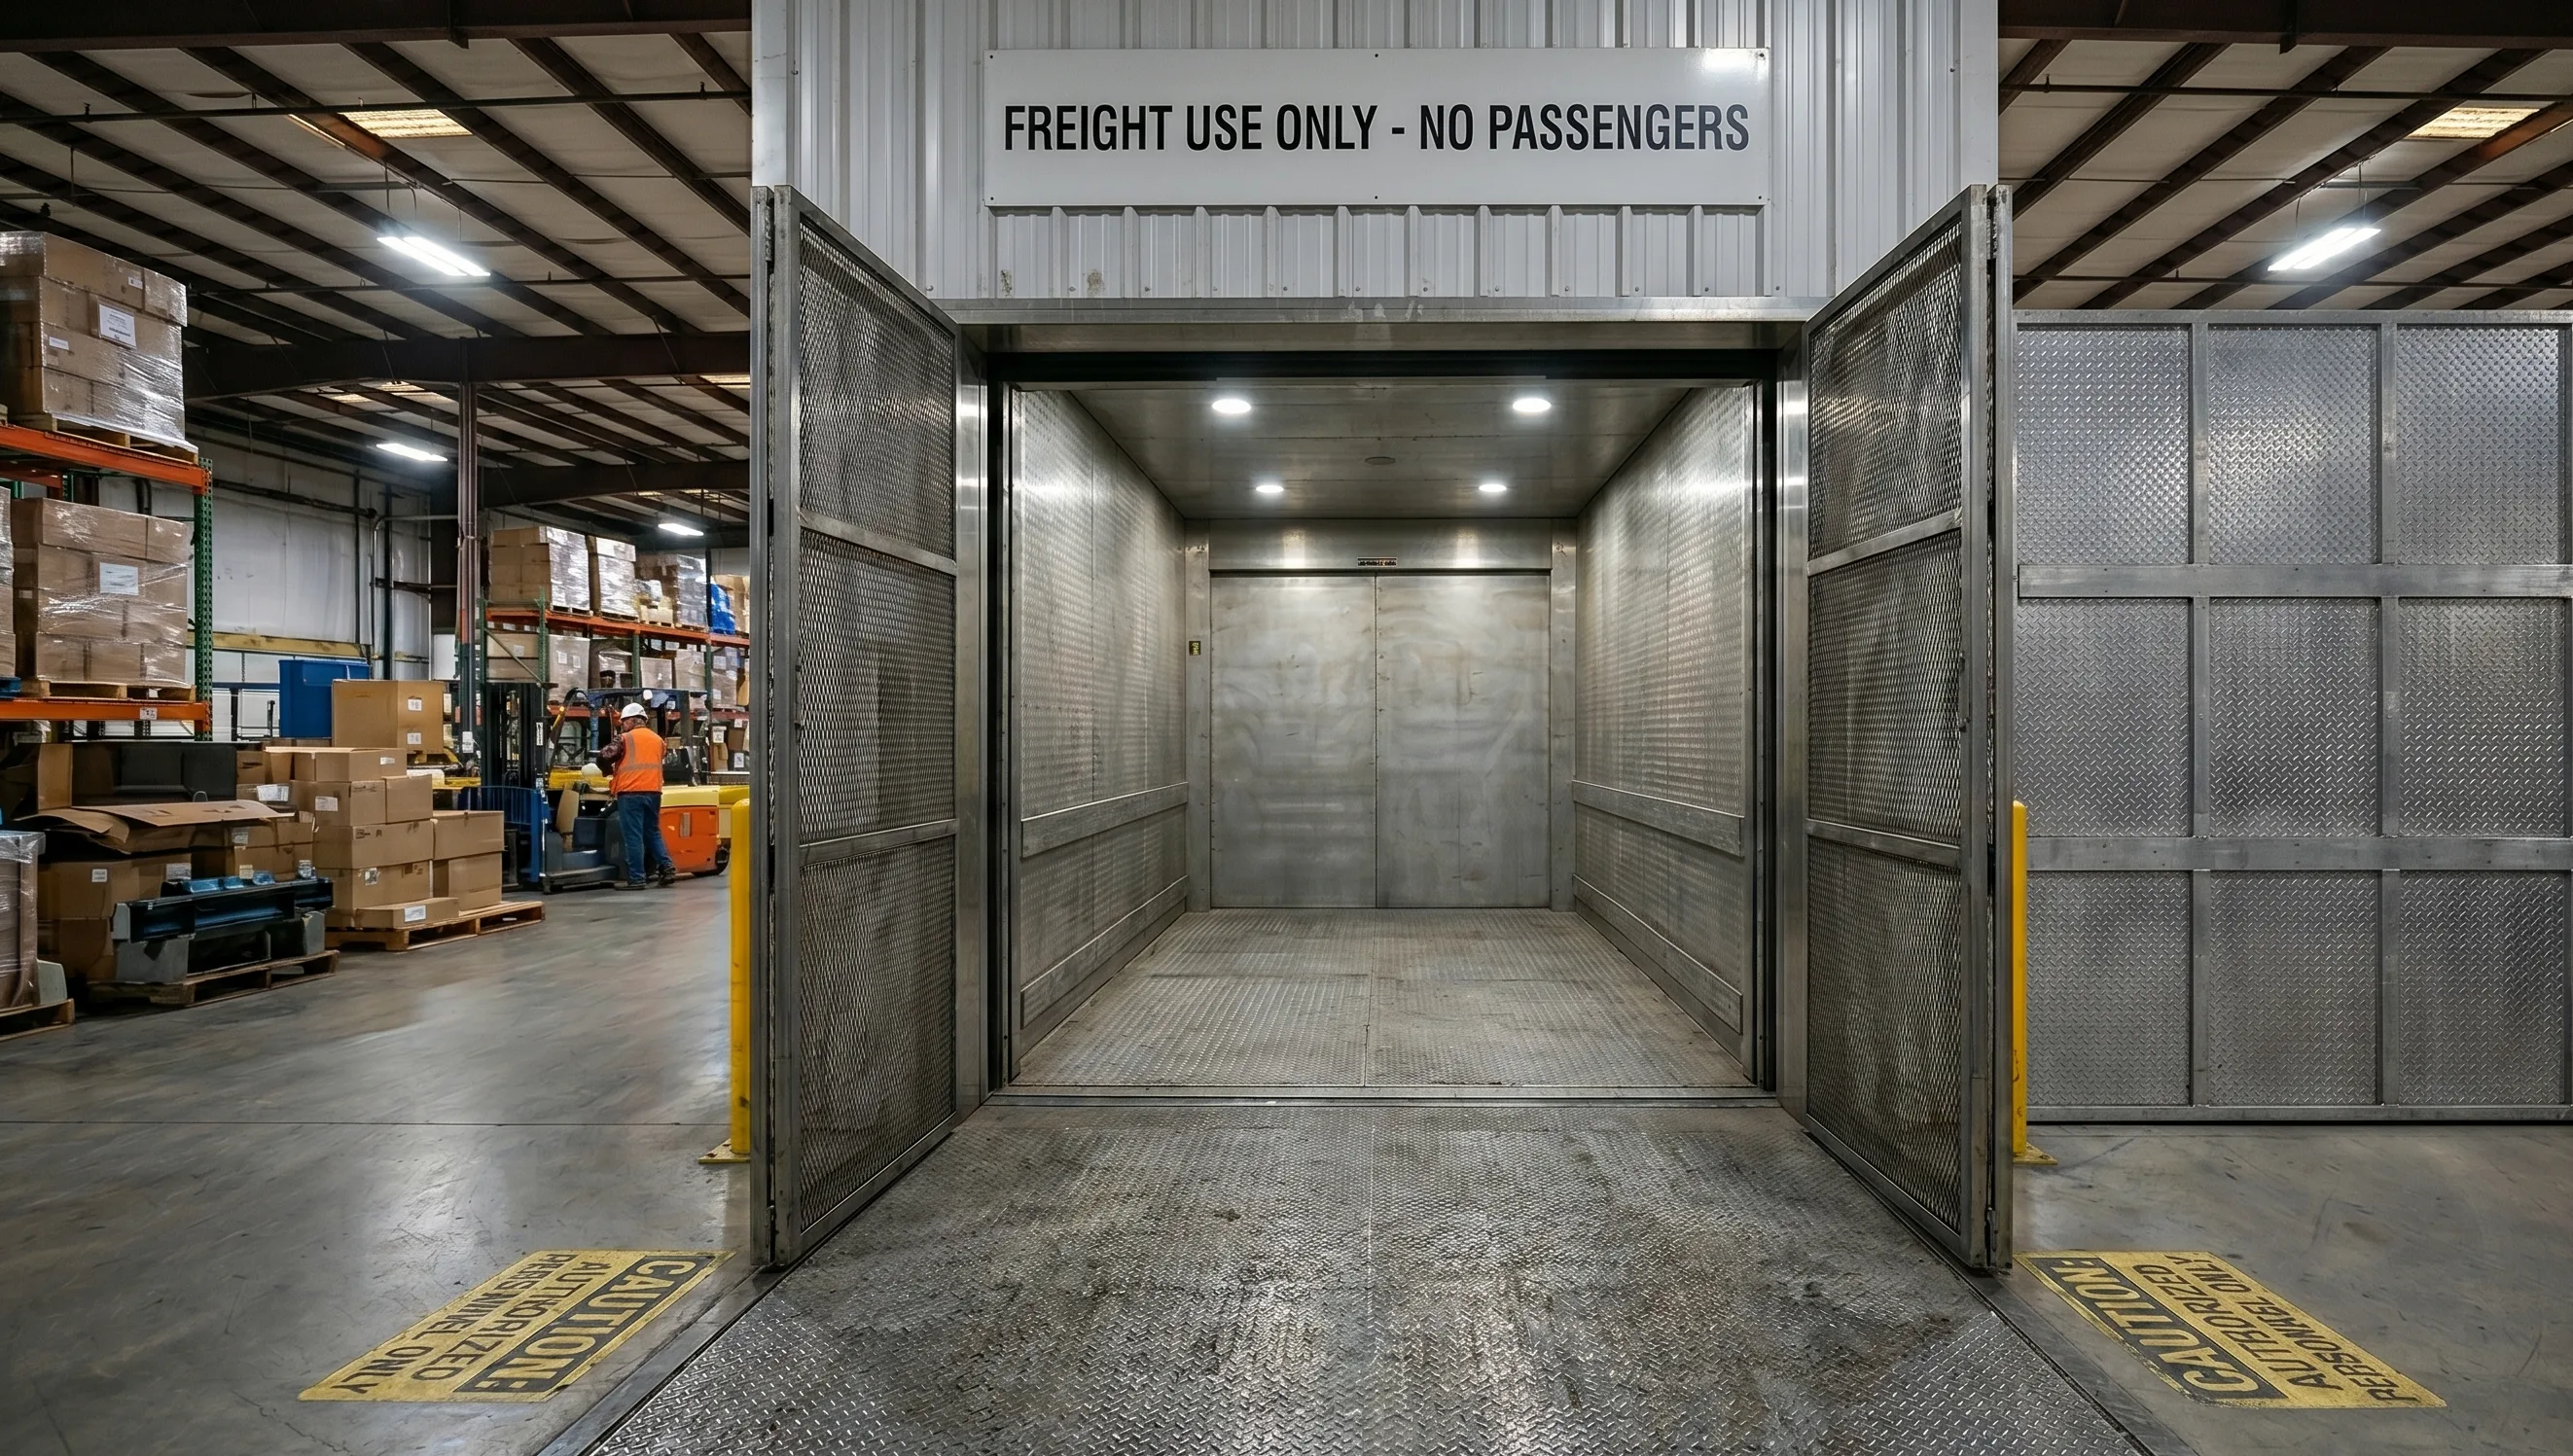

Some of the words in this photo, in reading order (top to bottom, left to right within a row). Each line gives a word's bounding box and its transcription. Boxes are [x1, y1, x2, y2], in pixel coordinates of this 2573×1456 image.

[1006, 105, 1172, 151] FREIGHT
[1187, 104, 1262, 151] USE
[1277, 104, 1377, 150] ONLY
[1421, 104, 1473, 150] NO
[1490, 104, 1748, 150] PASSENGERS
[472, 1261, 697, 1387] CAUTION:
[2054, 1261, 2259, 1390] CAUTION:
[330, 1346, 430, 1394] ONLY
